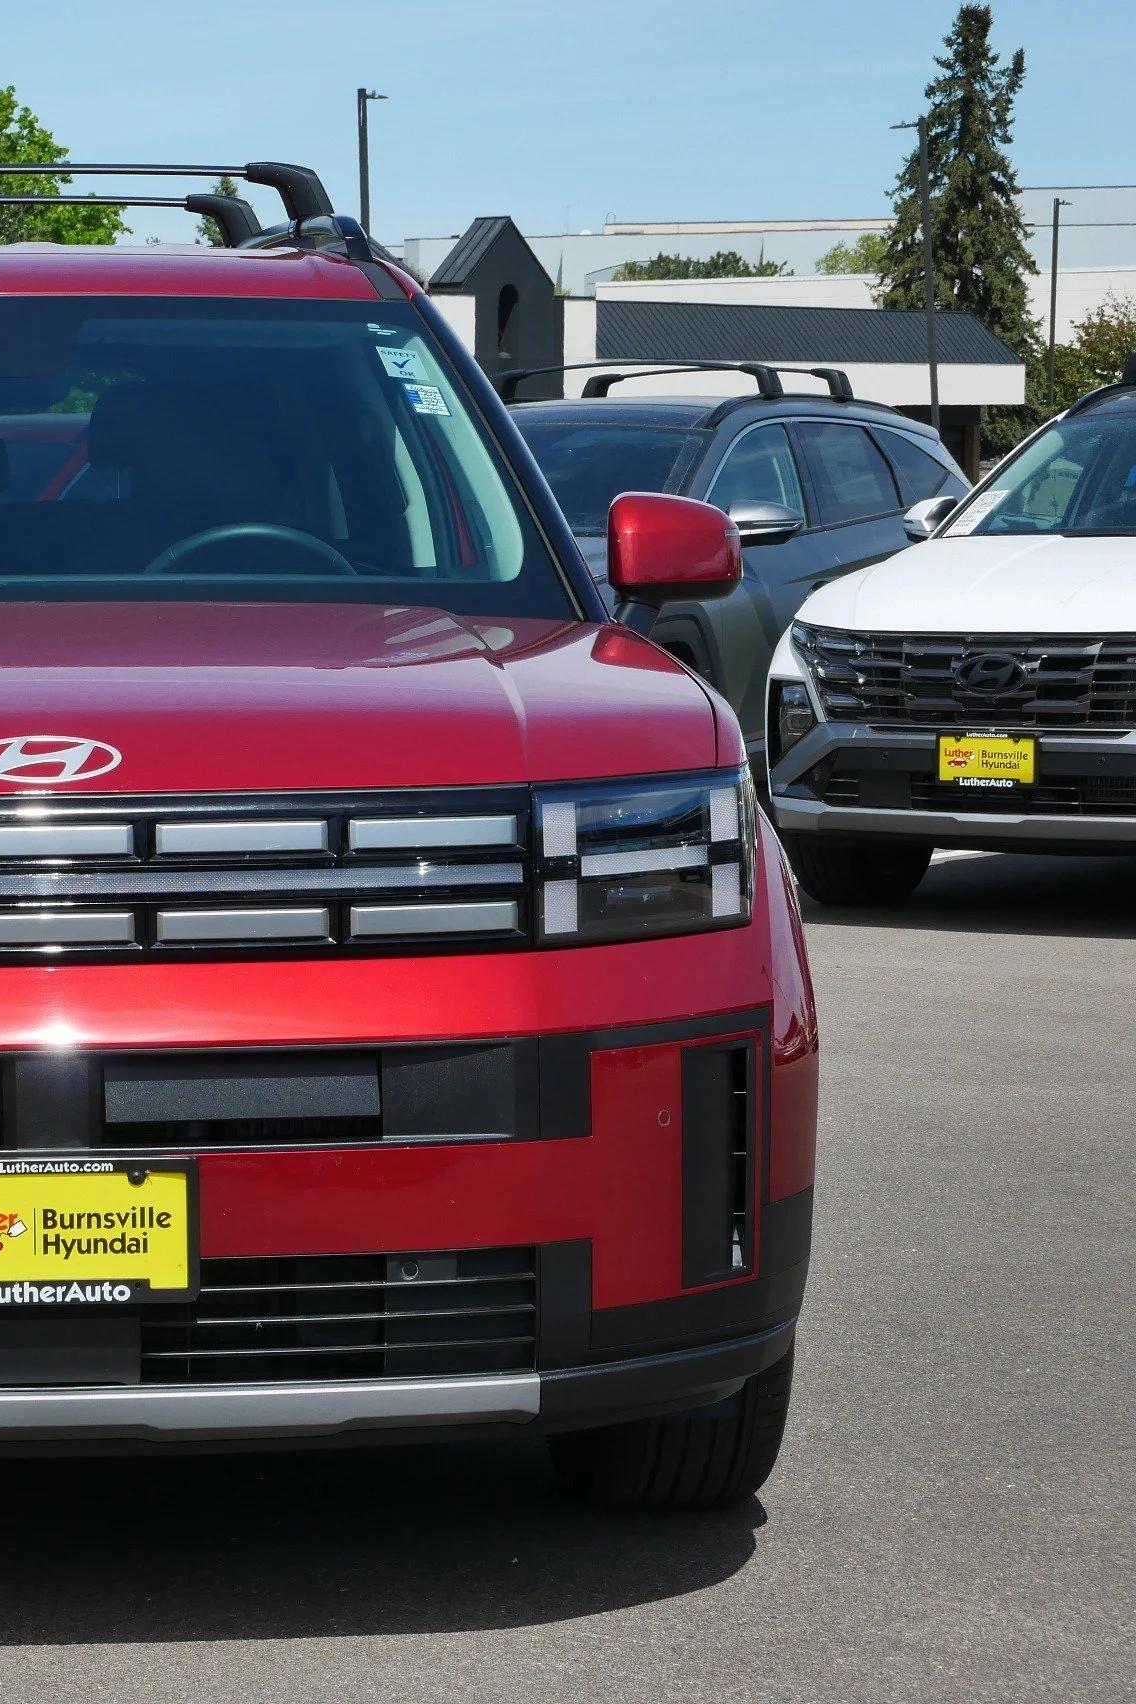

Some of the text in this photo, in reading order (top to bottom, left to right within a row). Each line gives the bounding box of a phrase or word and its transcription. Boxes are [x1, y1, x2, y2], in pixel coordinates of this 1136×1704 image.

[380, 350, 416, 359] SAFETY
[399, 370, 416, 378] OK
[944, 748, 973, 758] Luther
[981, 750, 1029, 760] Burnsville
[981, 760, 1020, 770] Hyundai
[959, 777, 1013, 788] LutherAuto
[0, 1161, 114, 1174] LutherAuto.com
[42, 1206, 172, 1230] Burnsville
[42, 1231, 149, 1260] Hyundai
